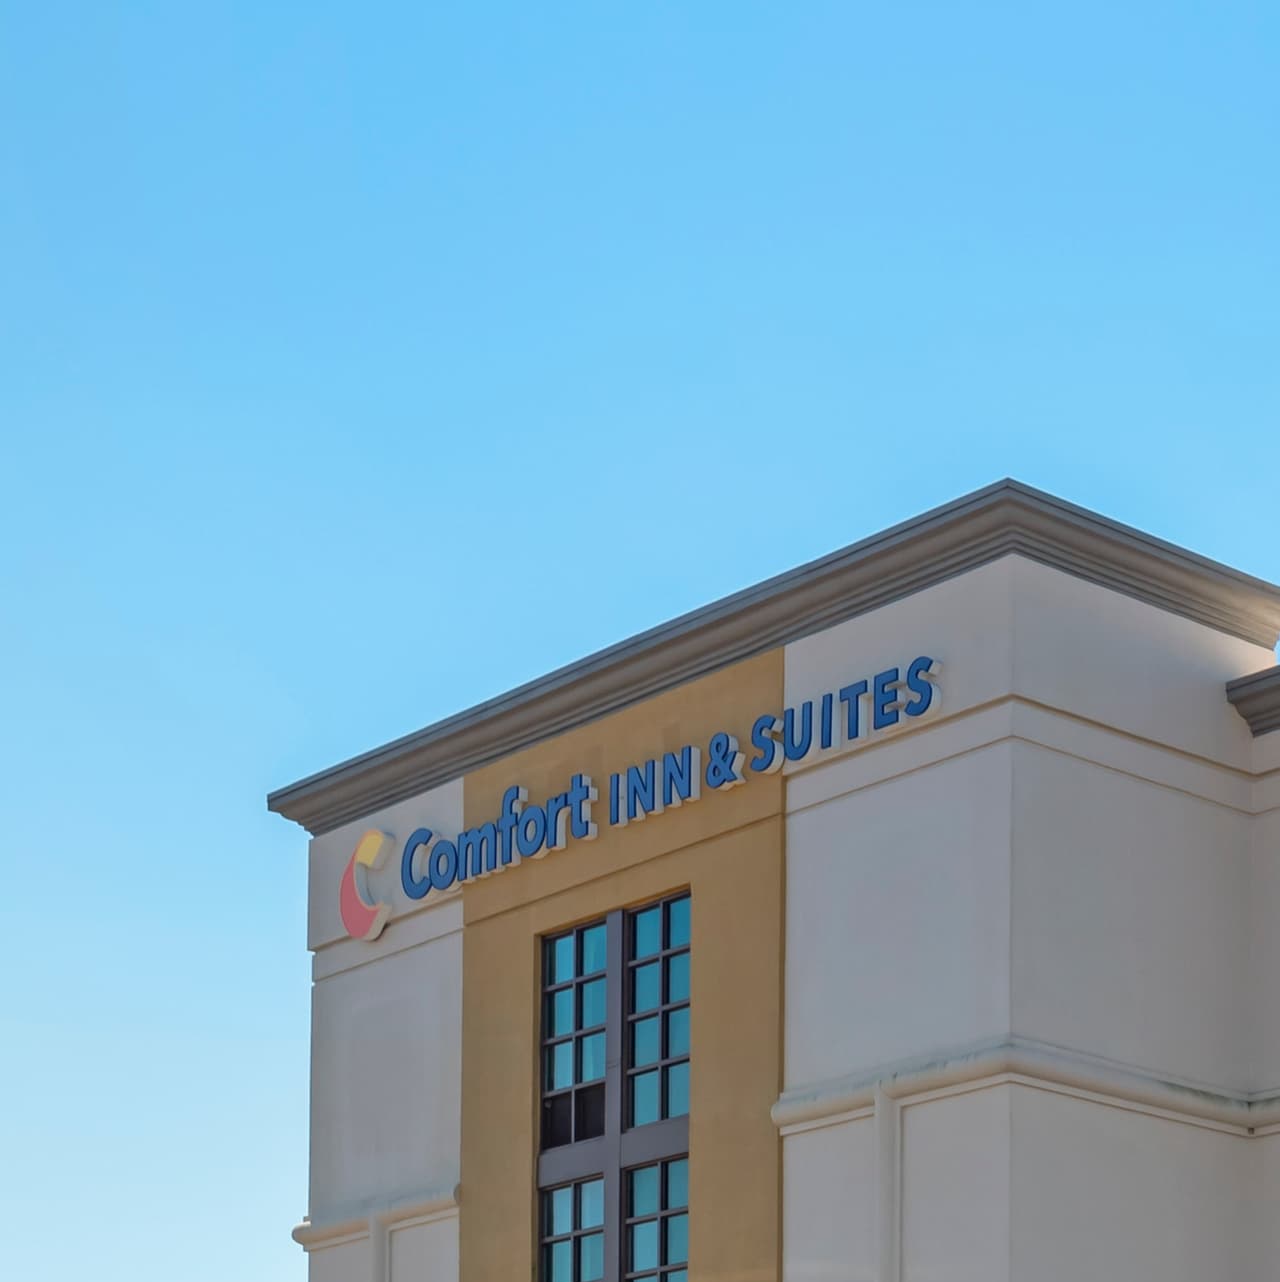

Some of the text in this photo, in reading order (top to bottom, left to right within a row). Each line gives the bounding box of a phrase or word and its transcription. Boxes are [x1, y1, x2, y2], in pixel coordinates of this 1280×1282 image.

[400, 655, 936, 900] Comfort INN & SUITES
